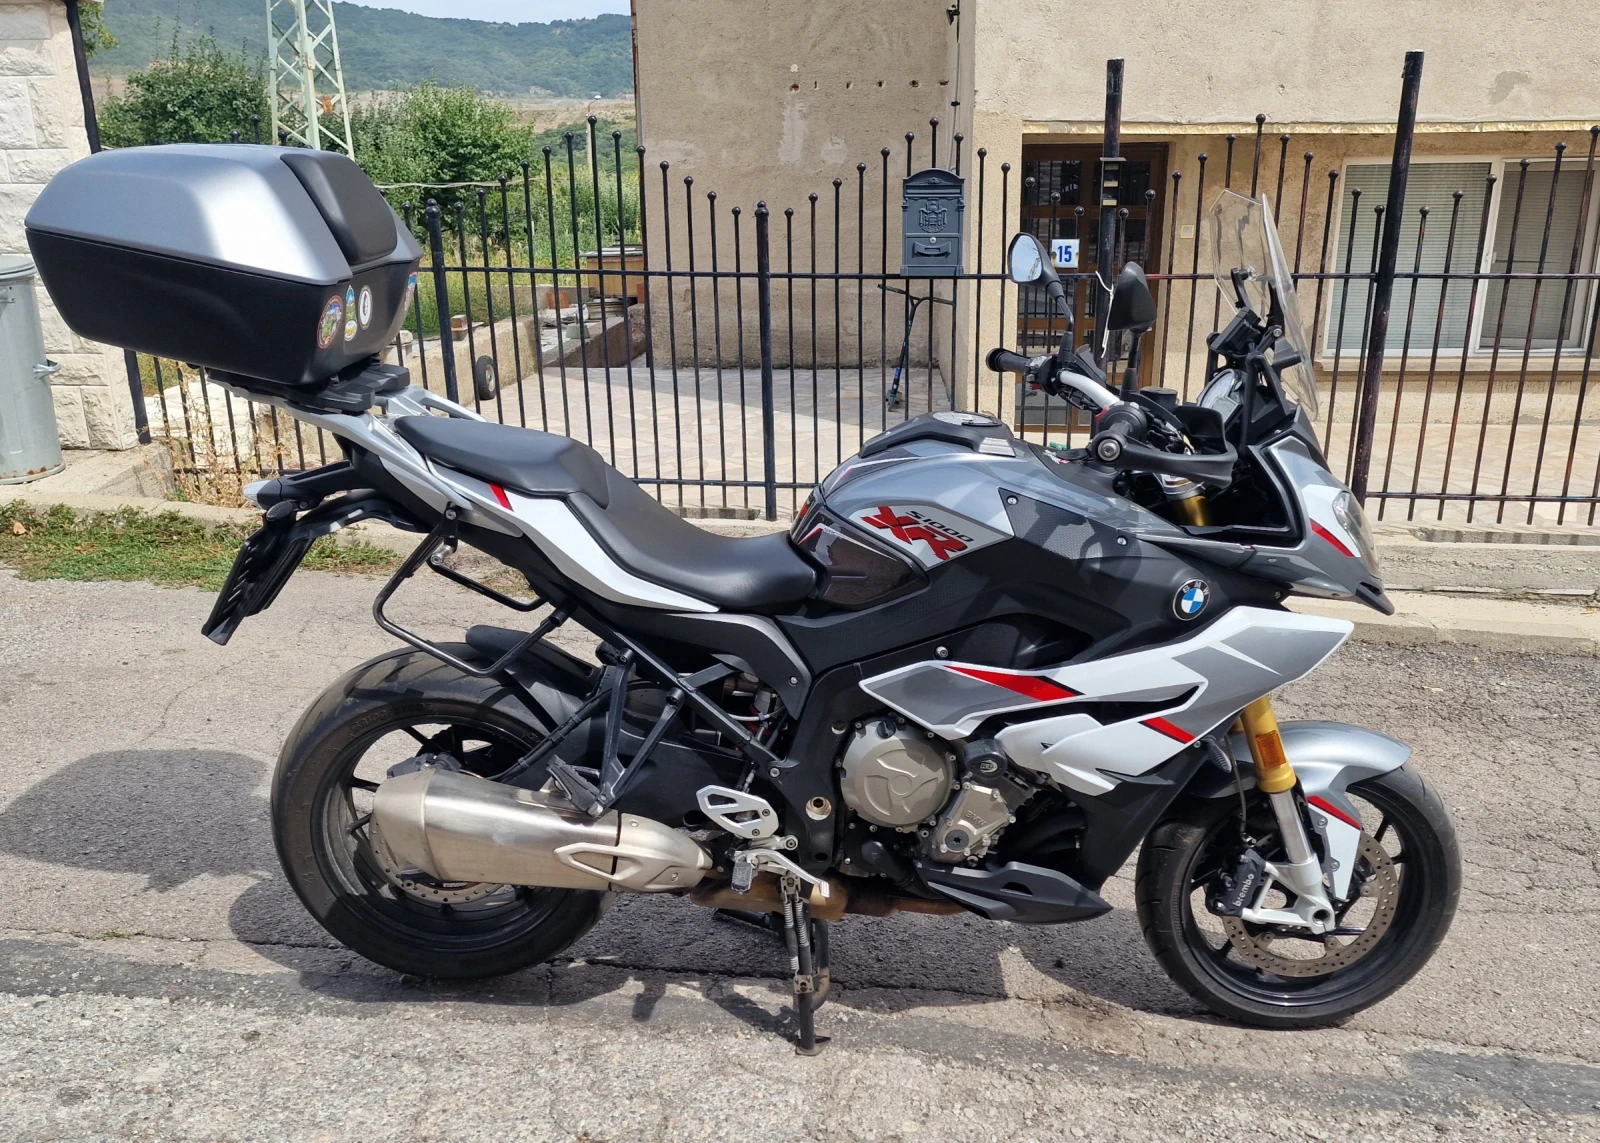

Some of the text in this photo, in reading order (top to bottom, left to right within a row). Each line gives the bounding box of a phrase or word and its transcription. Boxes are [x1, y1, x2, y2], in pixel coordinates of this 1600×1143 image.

[1057, 245, 1072, 263] 15
[860, 505, 969, 561] XR
[905, 510, 974, 543] S1000
[1181, 581, 1210, 596] BMW
[1232, 873, 1255, 907] brembo
